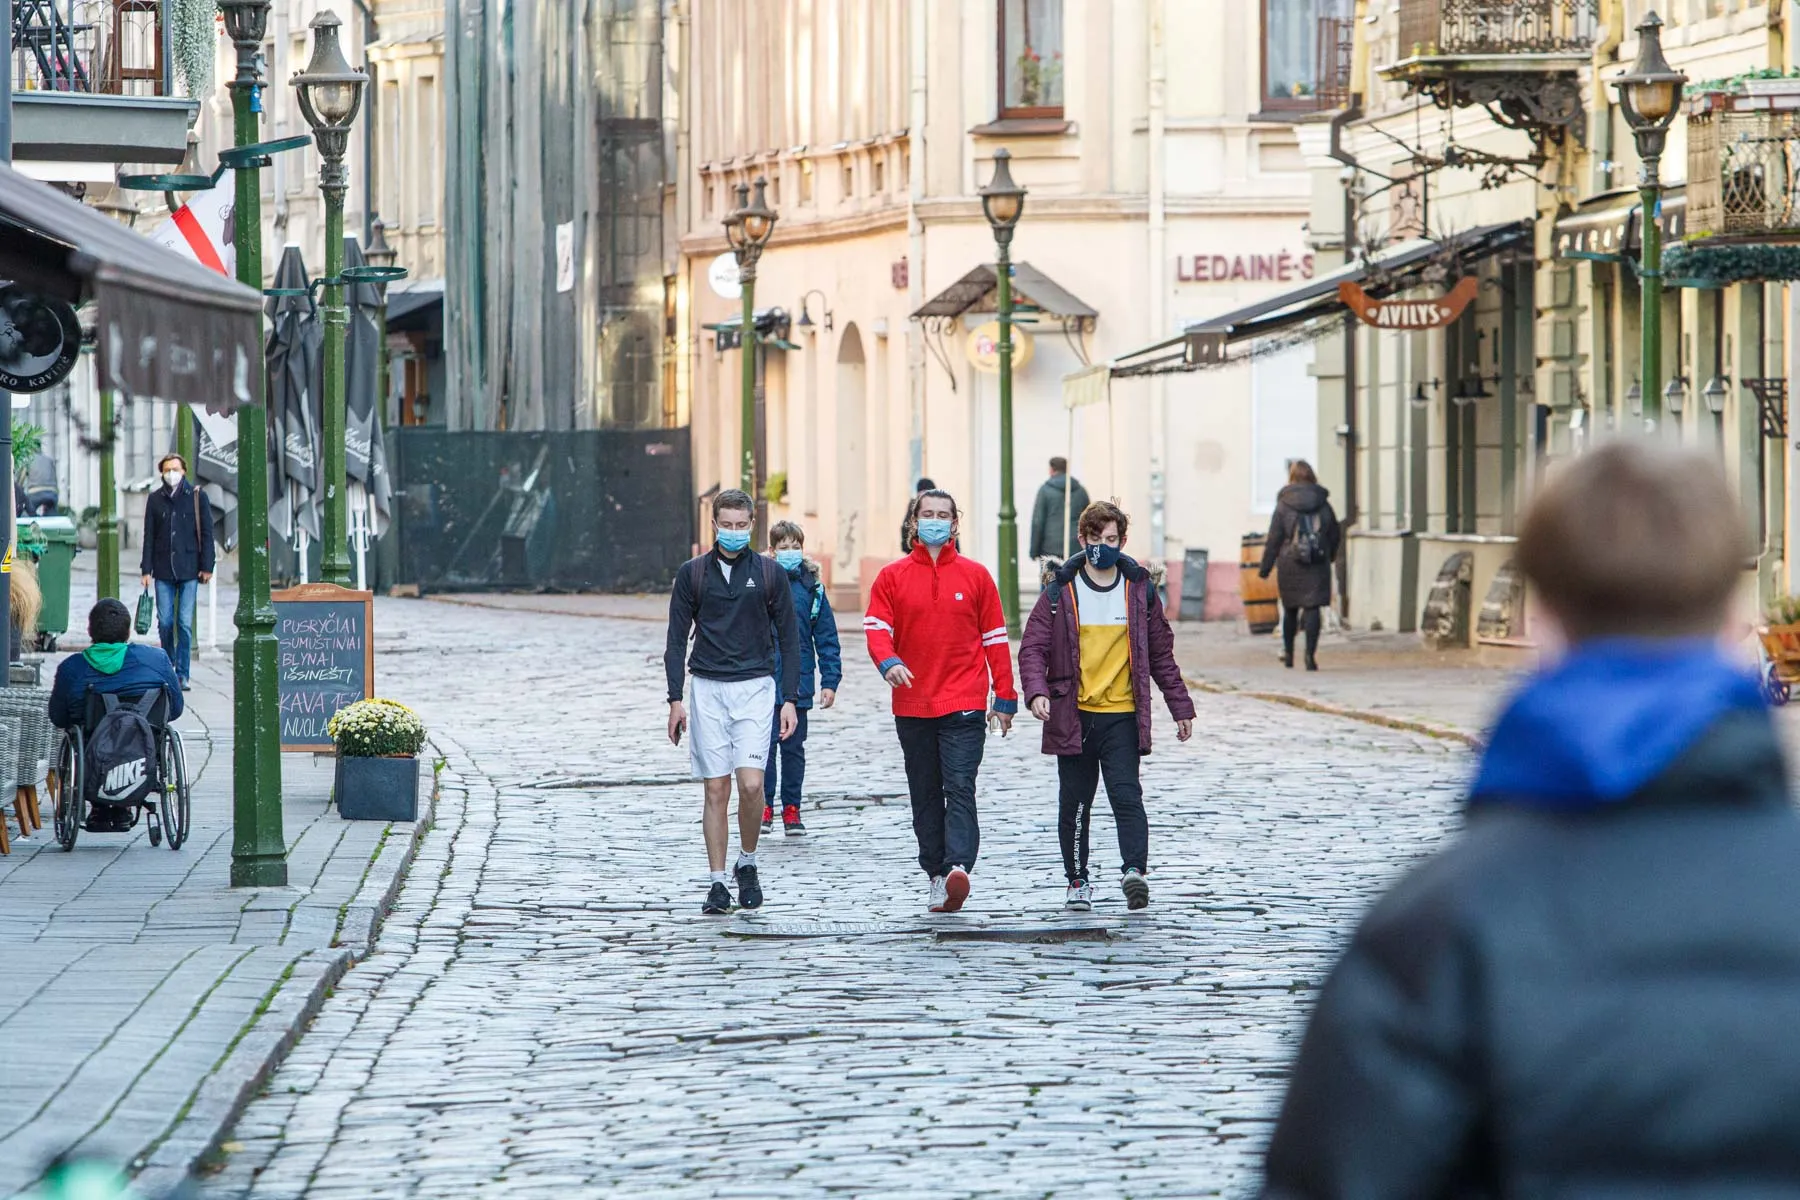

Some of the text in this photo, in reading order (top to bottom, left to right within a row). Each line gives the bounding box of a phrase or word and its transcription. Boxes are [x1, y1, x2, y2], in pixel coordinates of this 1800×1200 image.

[1377, 303, 1441, 326] AVILYS
[282, 611, 356, 635] PUSRYČIAI
[280, 634, 361, 650] SUMUŠTINIAI
[282, 652, 335, 667] BLYNAI
[283, 666, 353, 684] IŠSINEŠTI
[279, 692, 325, 714] KAVA
[104, 757, 146, 791] NIKE
